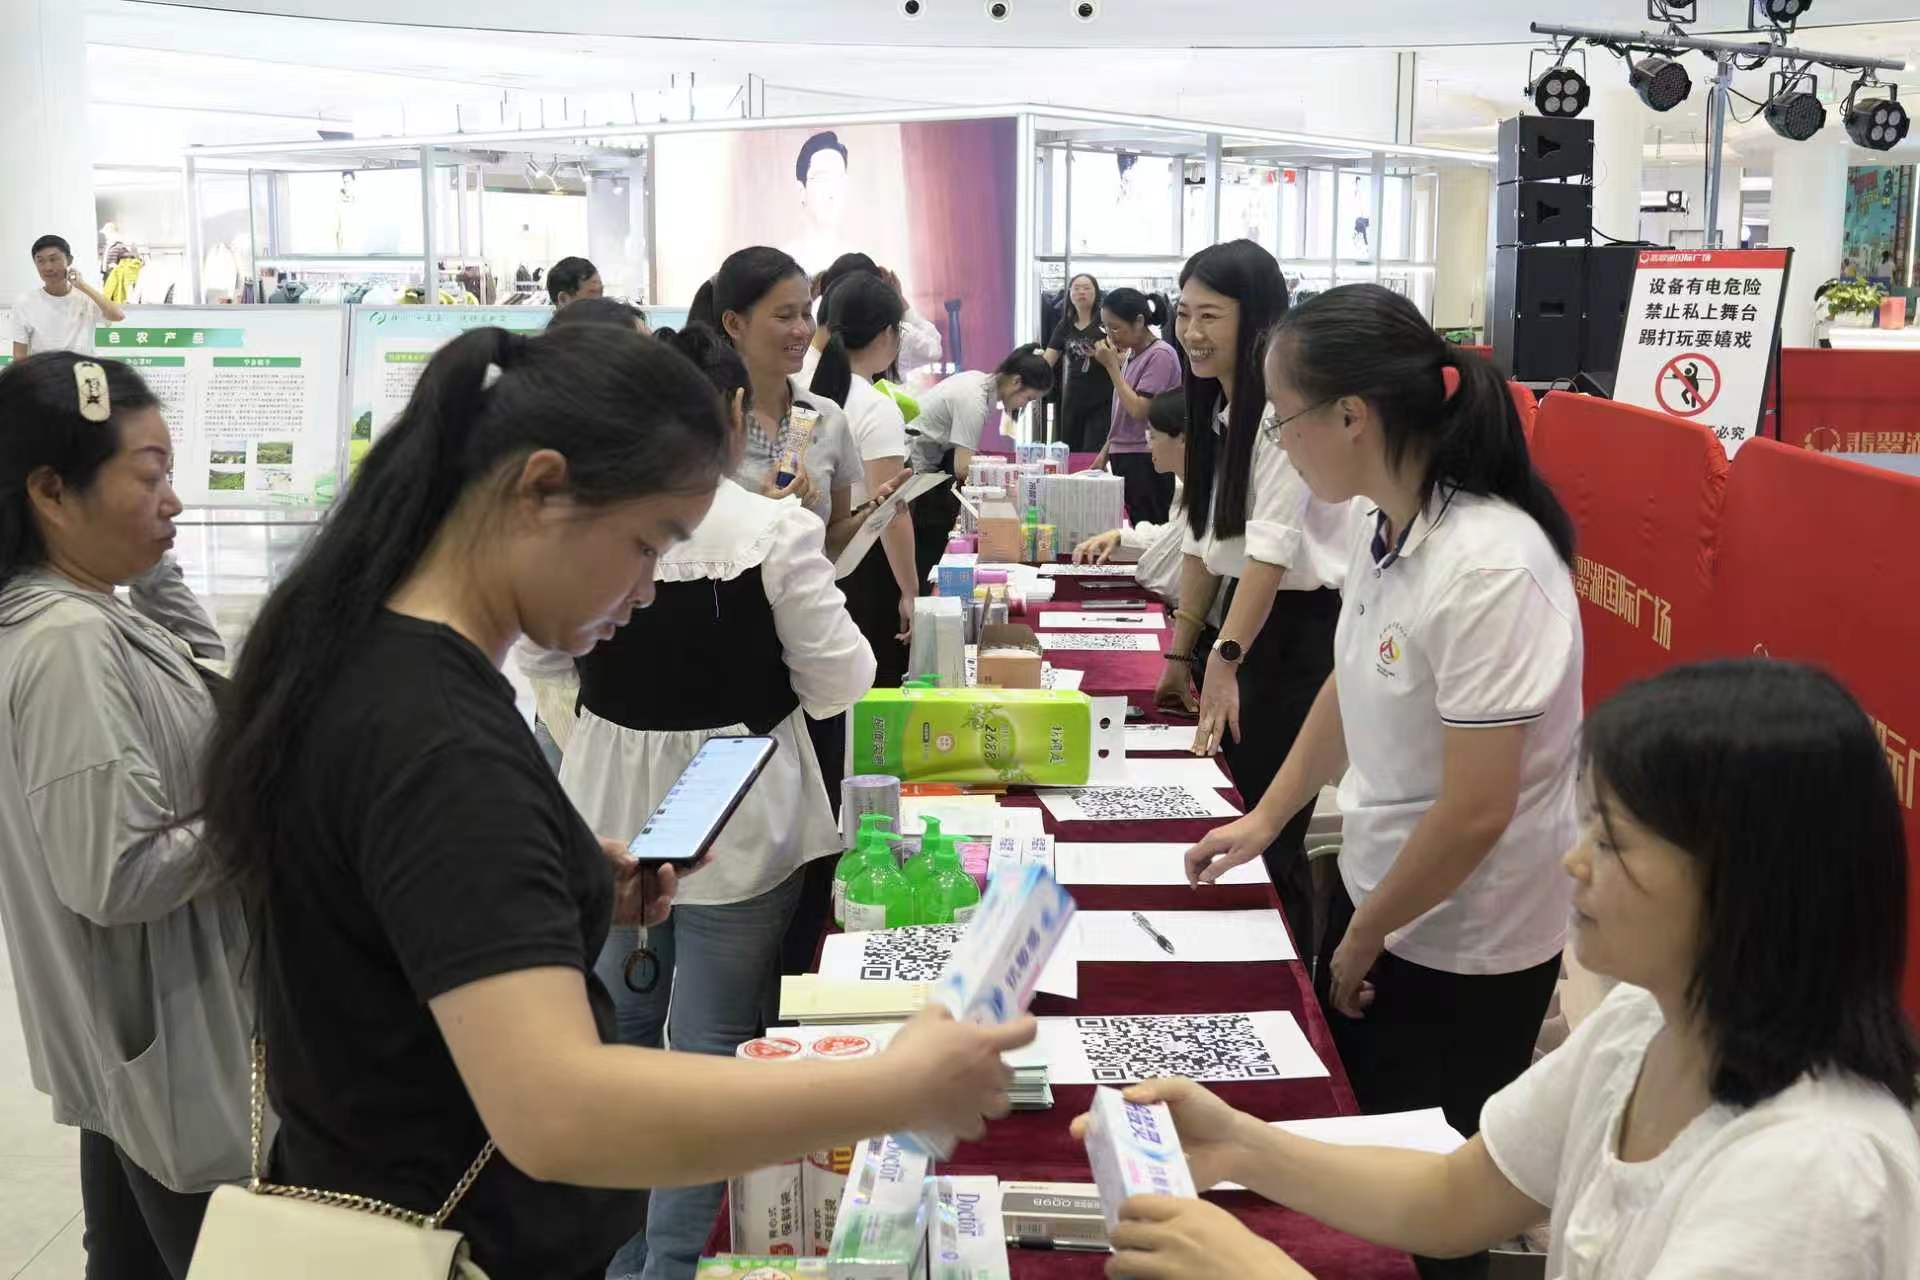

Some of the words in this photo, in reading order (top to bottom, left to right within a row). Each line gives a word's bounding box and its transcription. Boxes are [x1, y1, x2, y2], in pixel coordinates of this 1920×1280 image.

[1648, 277, 1762, 296] 设备有电危险
[1644, 303, 1758, 322] 禁止私上舞台
[1638, 328, 1753, 348] 踢打玩耍嬉戏
[1709, 425, 1745, 440] 必究
[984, 723, 999, 761] 2688
[956, 1192, 980, 1237] Doctor
